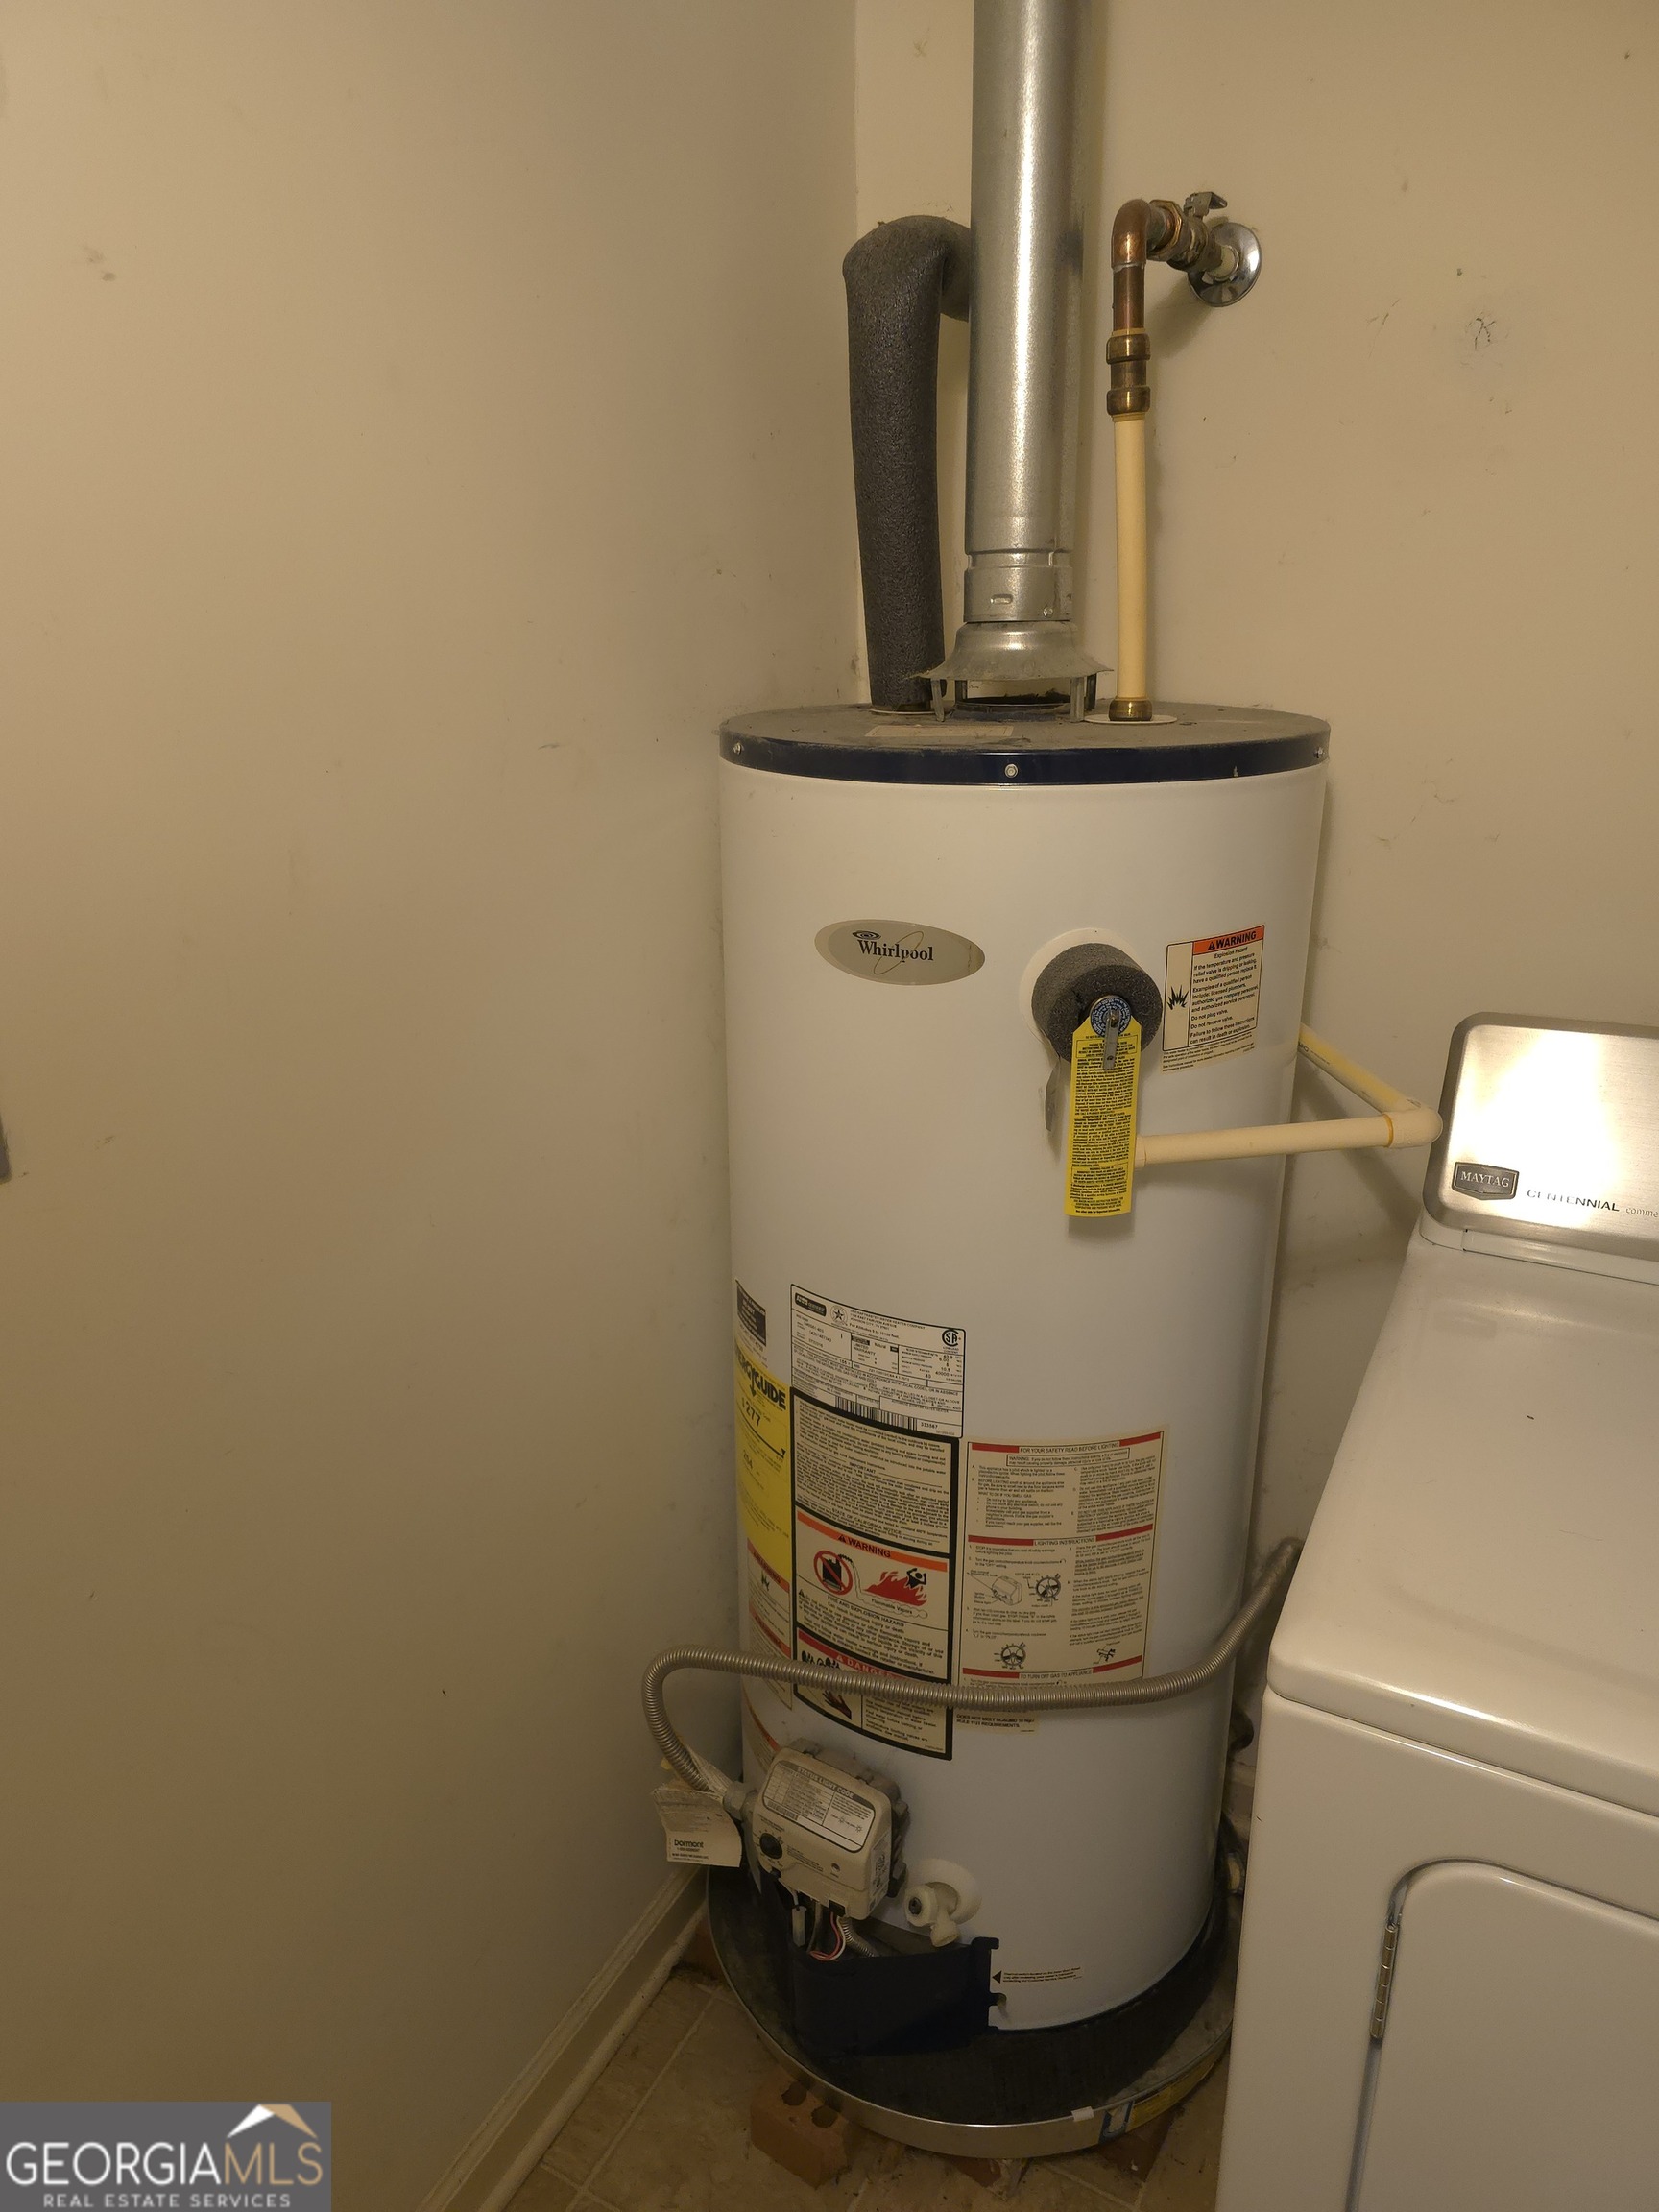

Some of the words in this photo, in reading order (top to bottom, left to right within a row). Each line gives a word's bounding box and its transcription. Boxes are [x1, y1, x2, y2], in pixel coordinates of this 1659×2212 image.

[1216, 931, 1256, 949] WARNING
[857, 939, 933, 962] Whirlpool
[1207, 958, 1231, 967] temperature
[1209, 972, 1226, 981] qualified
[1223, 977, 1239, 987] qualified
[1461, 1171, 1509, 1189] MAYTAG
[1527, 1189, 1620, 1212] CENTENNIAL
[854, 1516, 881, 1528] CALIFORNIA
[883, 1526, 902, 1535] NOTICE
[848, 1537, 891, 1558] WARNING
[1059, 1536, 1094, 1545] INSTRUCTIONS
[839, 1599, 850, 1607] AND
[851, 1603, 879, 1619] EXPLOSION
[880, 1616, 904, 1627] HAZARD
[798, 1767, 818, 1781] STATUS
[819, 1778, 836, 1790] LIGHT
[836, 1787, 854, 1799] CODE
[674, 1839, 704, 1848] Dormont
